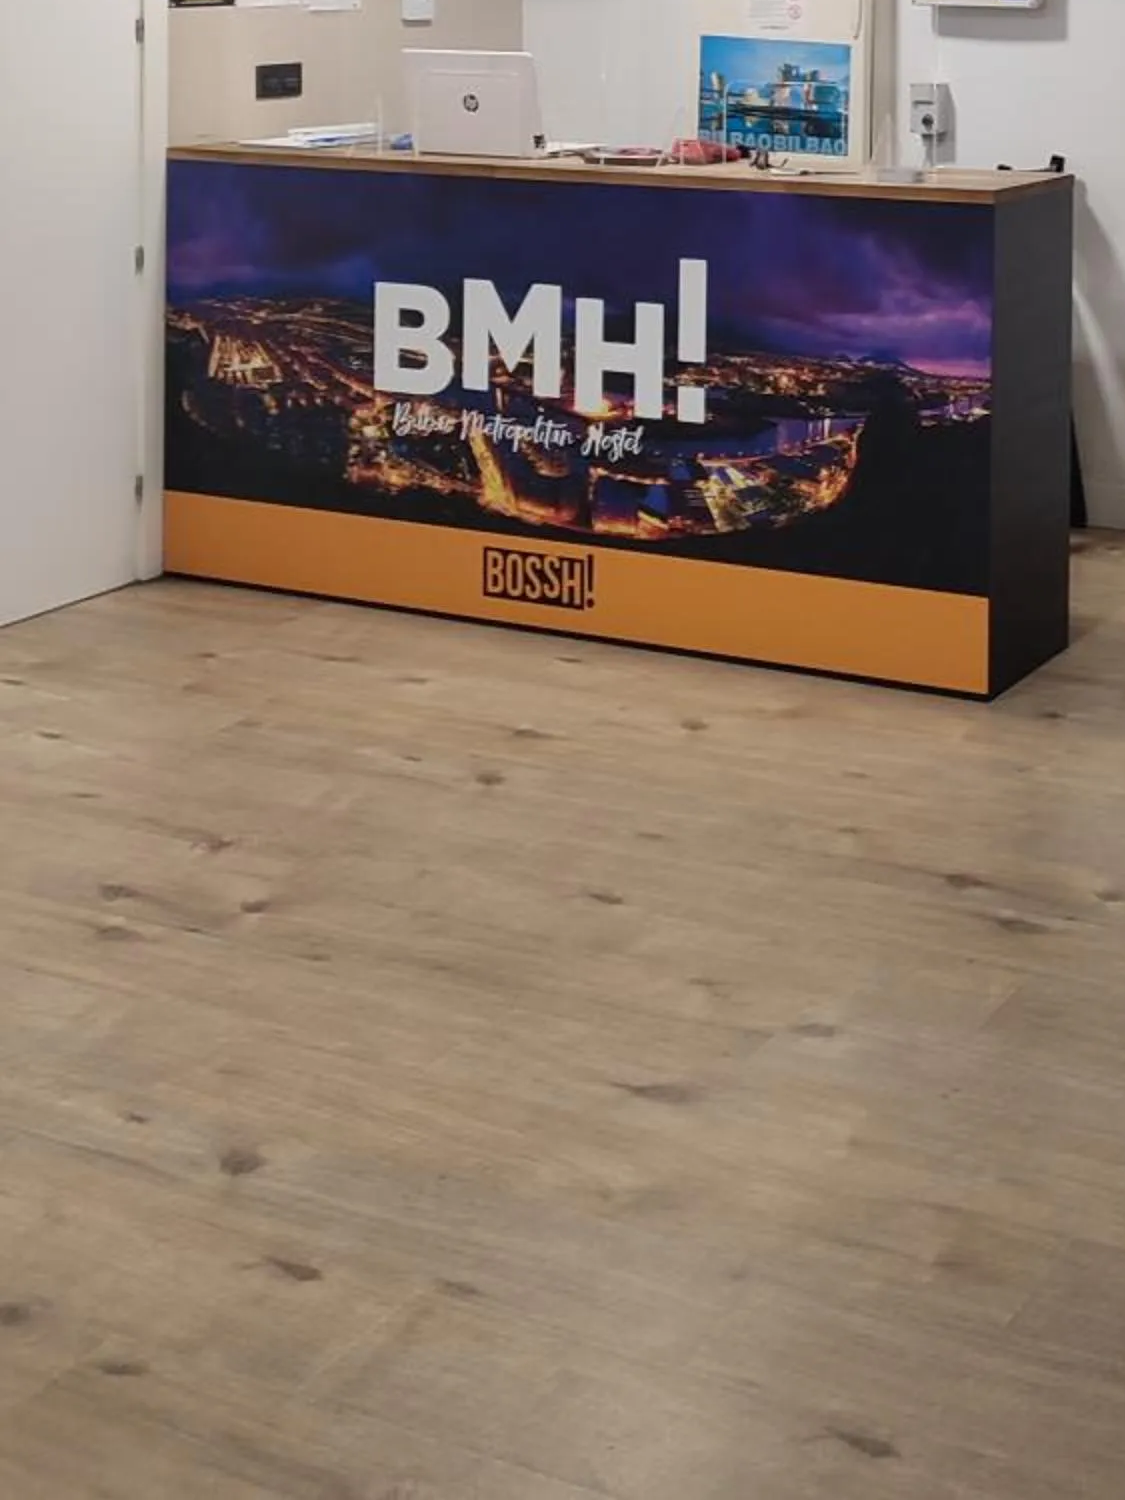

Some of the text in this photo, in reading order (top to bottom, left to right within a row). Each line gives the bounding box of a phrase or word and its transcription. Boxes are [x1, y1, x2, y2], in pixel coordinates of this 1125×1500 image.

[374, 258, 707, 424] BMH!
[460, 408, 575, 452] Metropolitan
[581, 425, 644, 462] Hostel
[485, 550, 595, 609] BOSSH!
